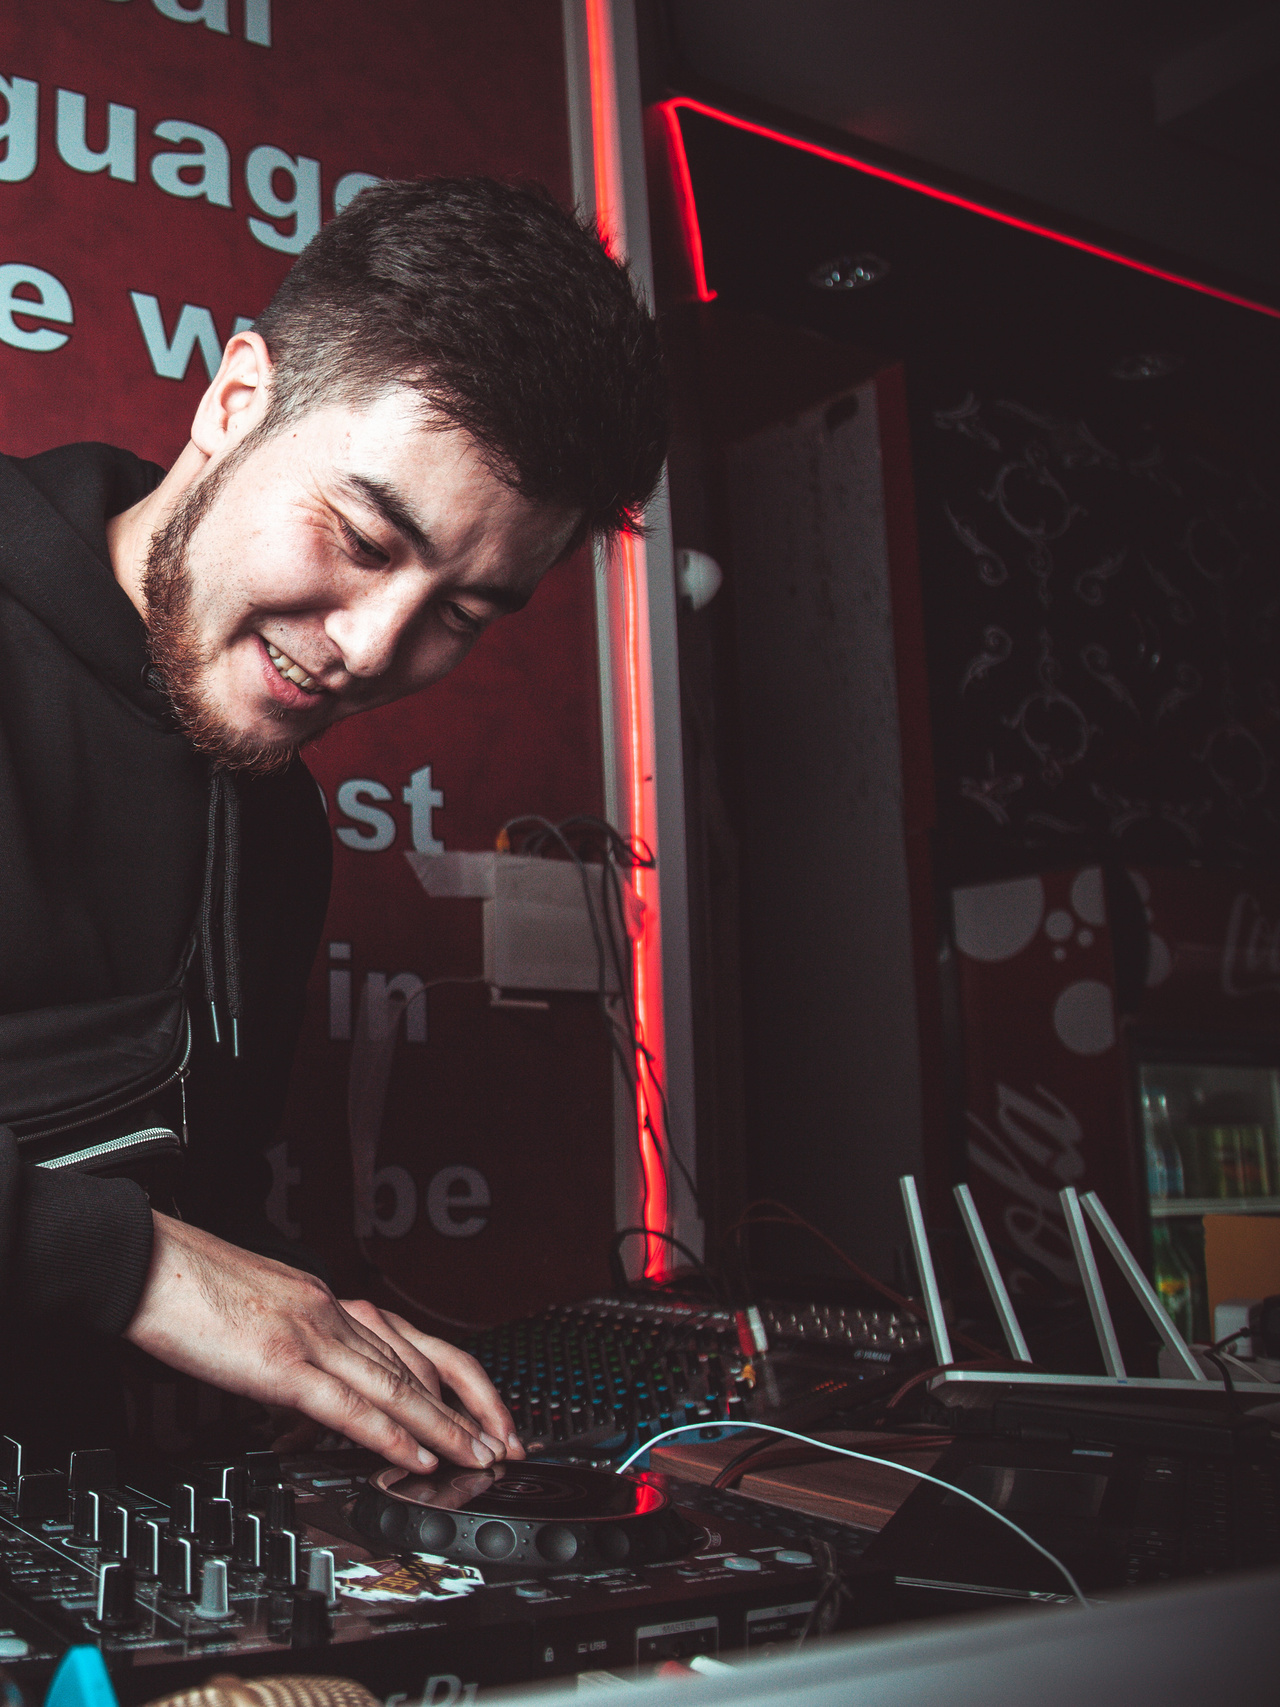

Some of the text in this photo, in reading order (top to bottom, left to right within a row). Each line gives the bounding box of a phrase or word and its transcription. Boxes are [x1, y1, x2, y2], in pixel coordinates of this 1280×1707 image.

[320, 764, 444, 855] st
[328, 941, 428, 1043] in
[354, 1135, 492, 1238] be
[589, 1640, 607, 1652] USB
[662, 1620, 697, 1633] MASTER
